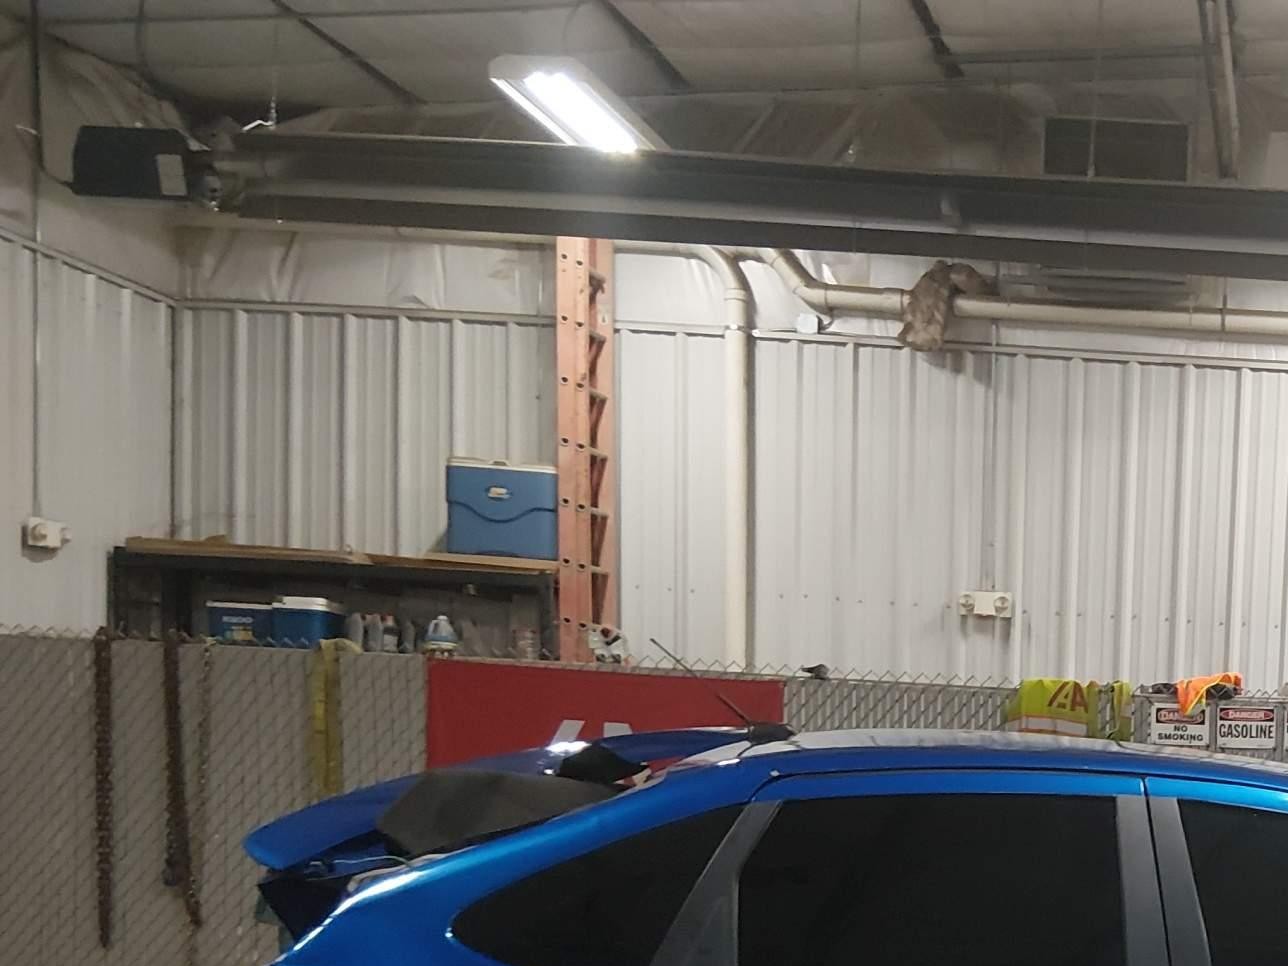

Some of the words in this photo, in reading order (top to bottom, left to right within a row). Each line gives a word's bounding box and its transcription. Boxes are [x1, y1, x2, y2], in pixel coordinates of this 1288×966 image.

[1228, 710, 1265, 719] DANGER
[1173, 724, 1188, 732] NO
[1219, 723, 1274, 739] GASOLINE
[1157, 732, 1204, 742] SMOKING
